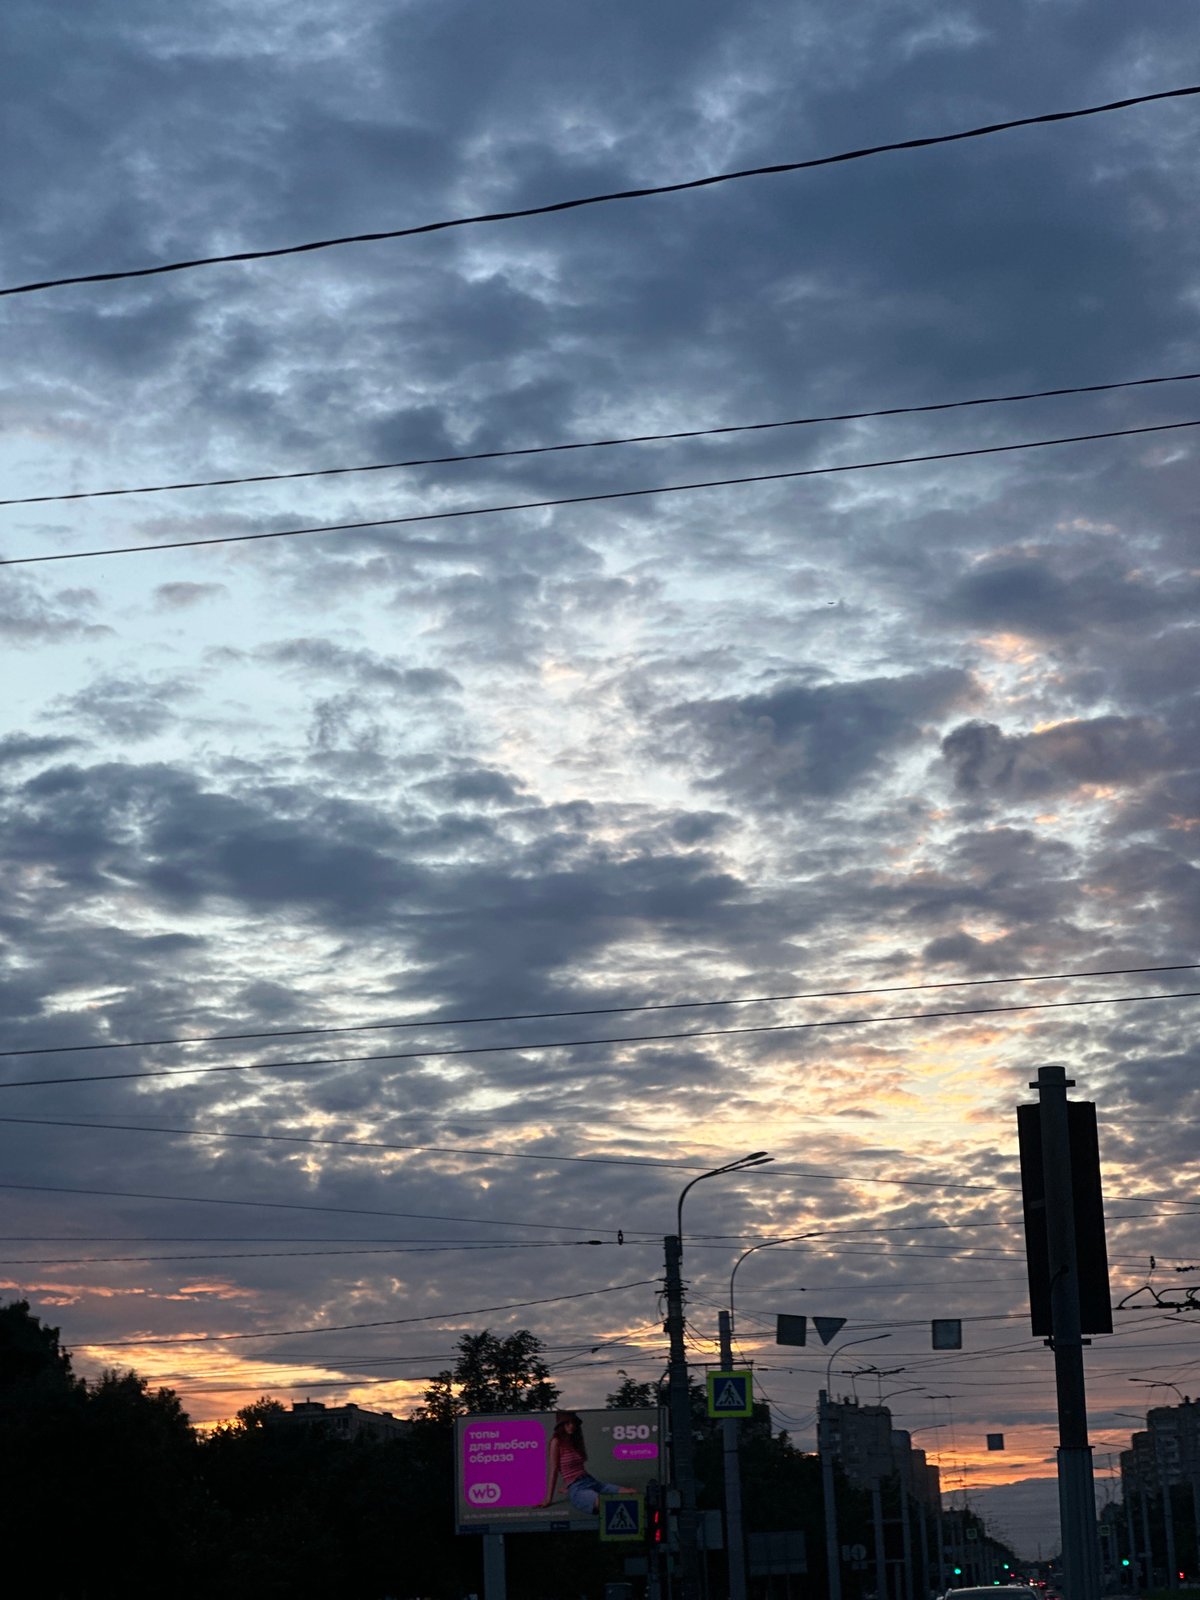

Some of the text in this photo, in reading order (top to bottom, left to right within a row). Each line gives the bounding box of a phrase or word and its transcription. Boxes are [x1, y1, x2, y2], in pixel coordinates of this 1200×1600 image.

[469, 1431, 500, 1439] топы
[613, 1425, 650, 1440] 850
[469, 1439, 538, 1452] для любого
[469, 1452, 514, 1464] образа
[472, 1484, 497, 1499] wb
